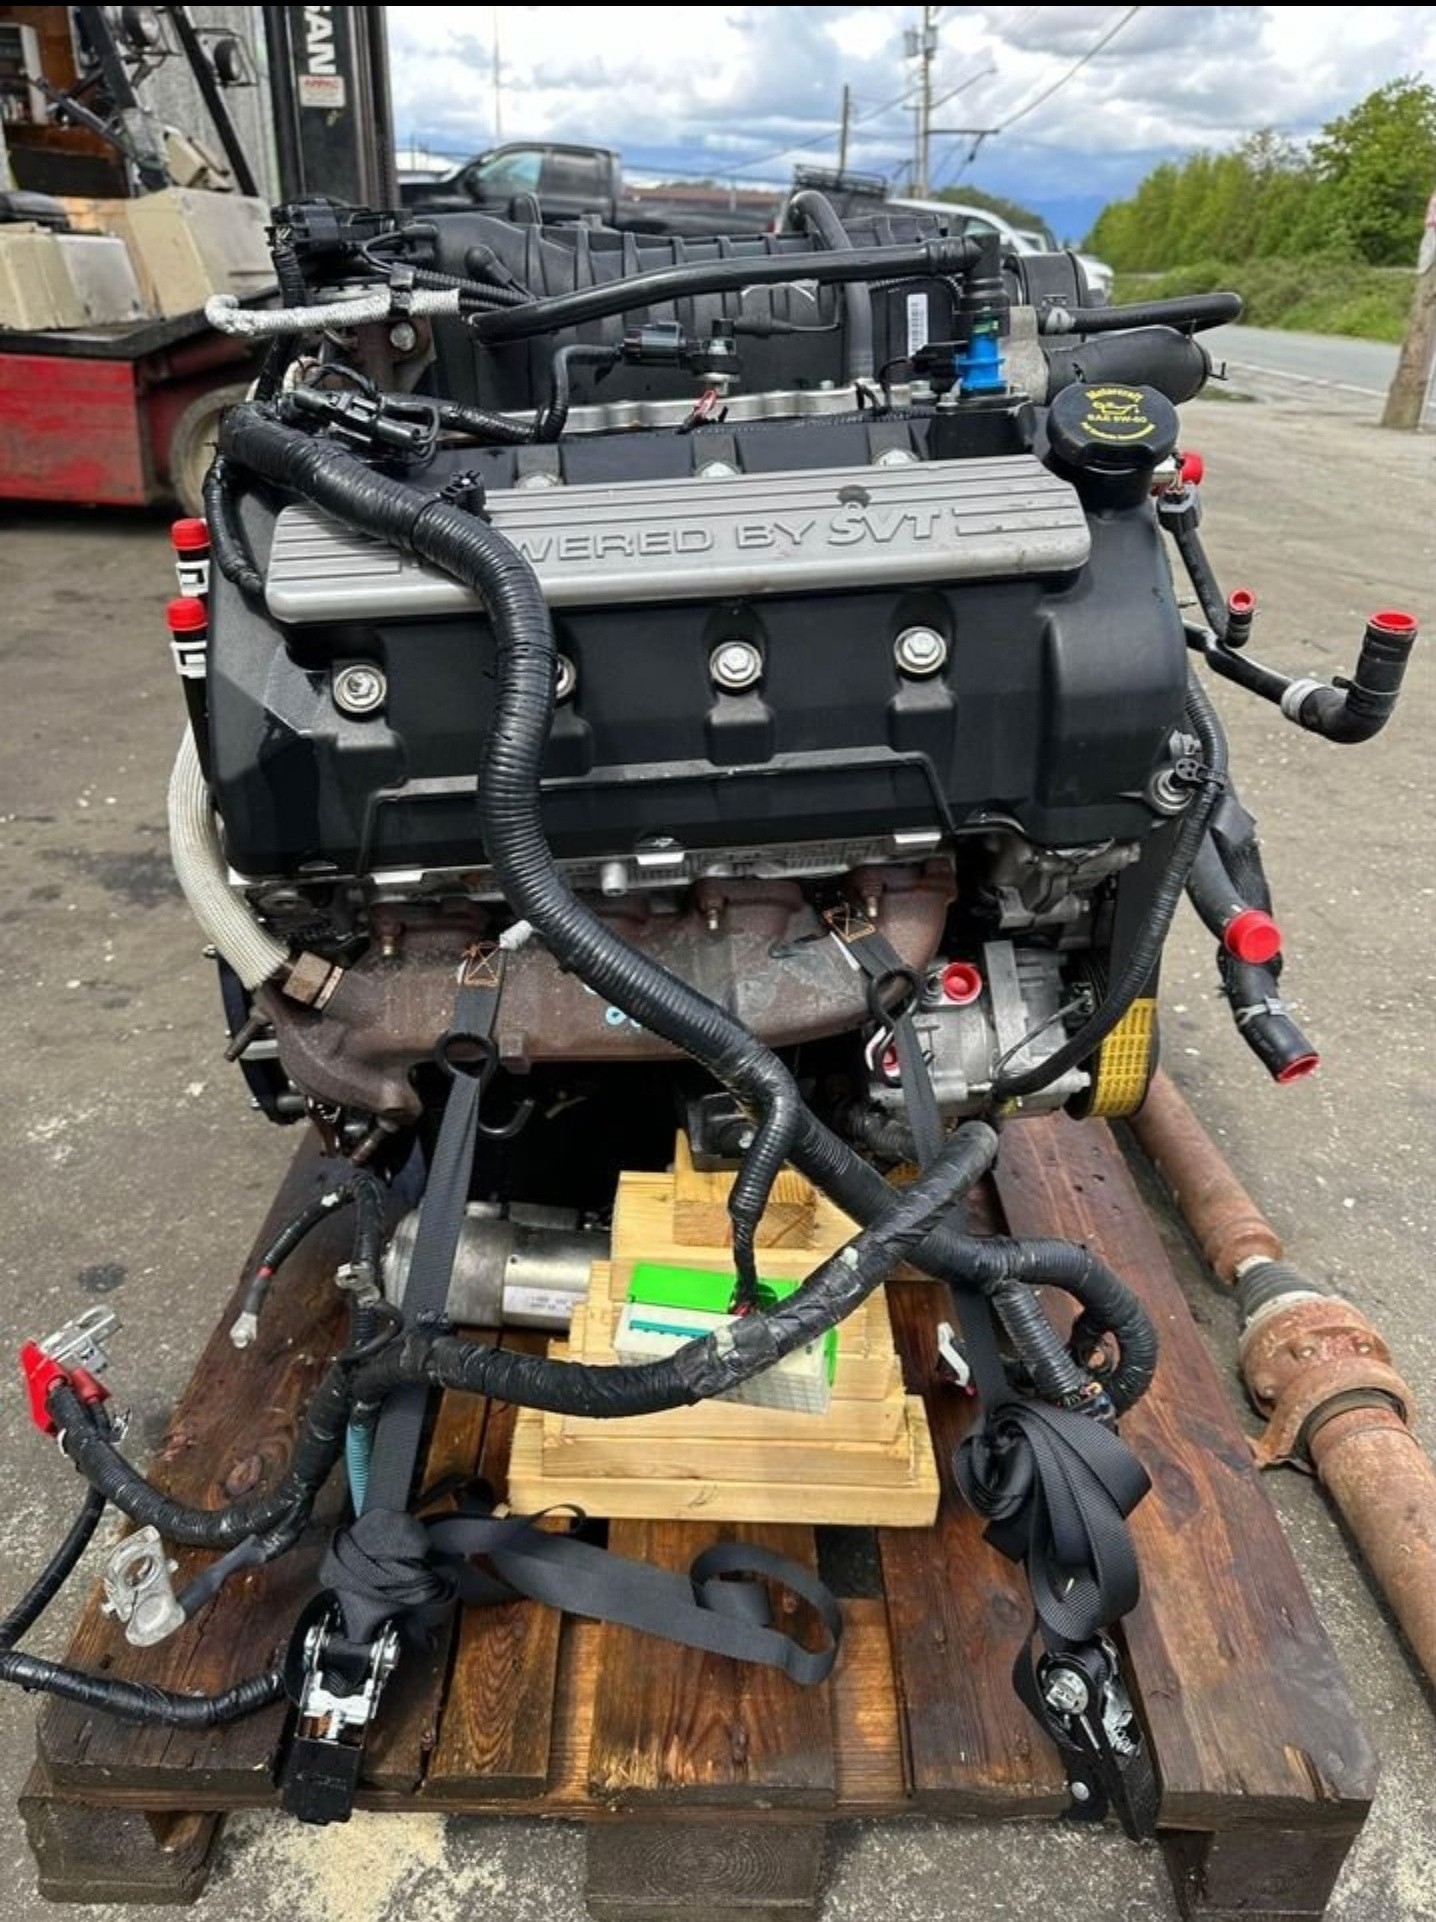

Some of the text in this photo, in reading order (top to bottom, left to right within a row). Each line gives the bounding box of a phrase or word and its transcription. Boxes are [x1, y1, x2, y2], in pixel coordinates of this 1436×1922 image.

[304, 6, 337, 74] AN
[516, 500, 942, 563] WERED BY SVT
